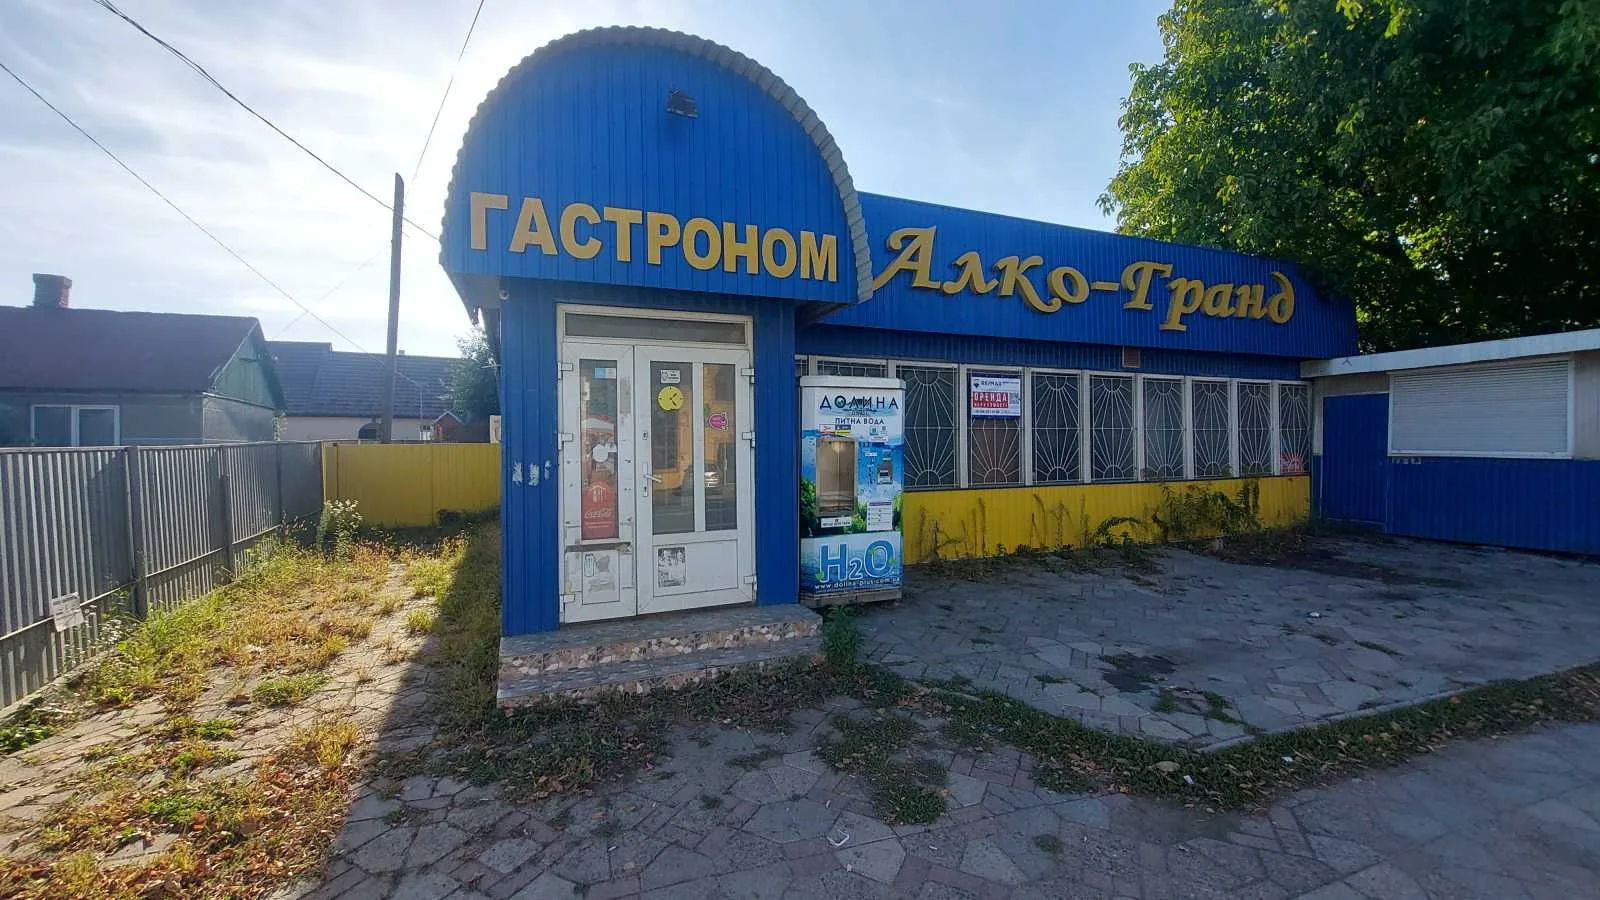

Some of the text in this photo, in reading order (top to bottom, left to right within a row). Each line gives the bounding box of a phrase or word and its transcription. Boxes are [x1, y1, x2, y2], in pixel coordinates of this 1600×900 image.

[469, 191, 838, 283] ГАСТРОНОМ
[820, 395, 899, 410] ДОЛИНА
[974, 392, 1008, 402] ОРЕНДА
[835, 417, 885, 425] ПИТНА ВОДА
